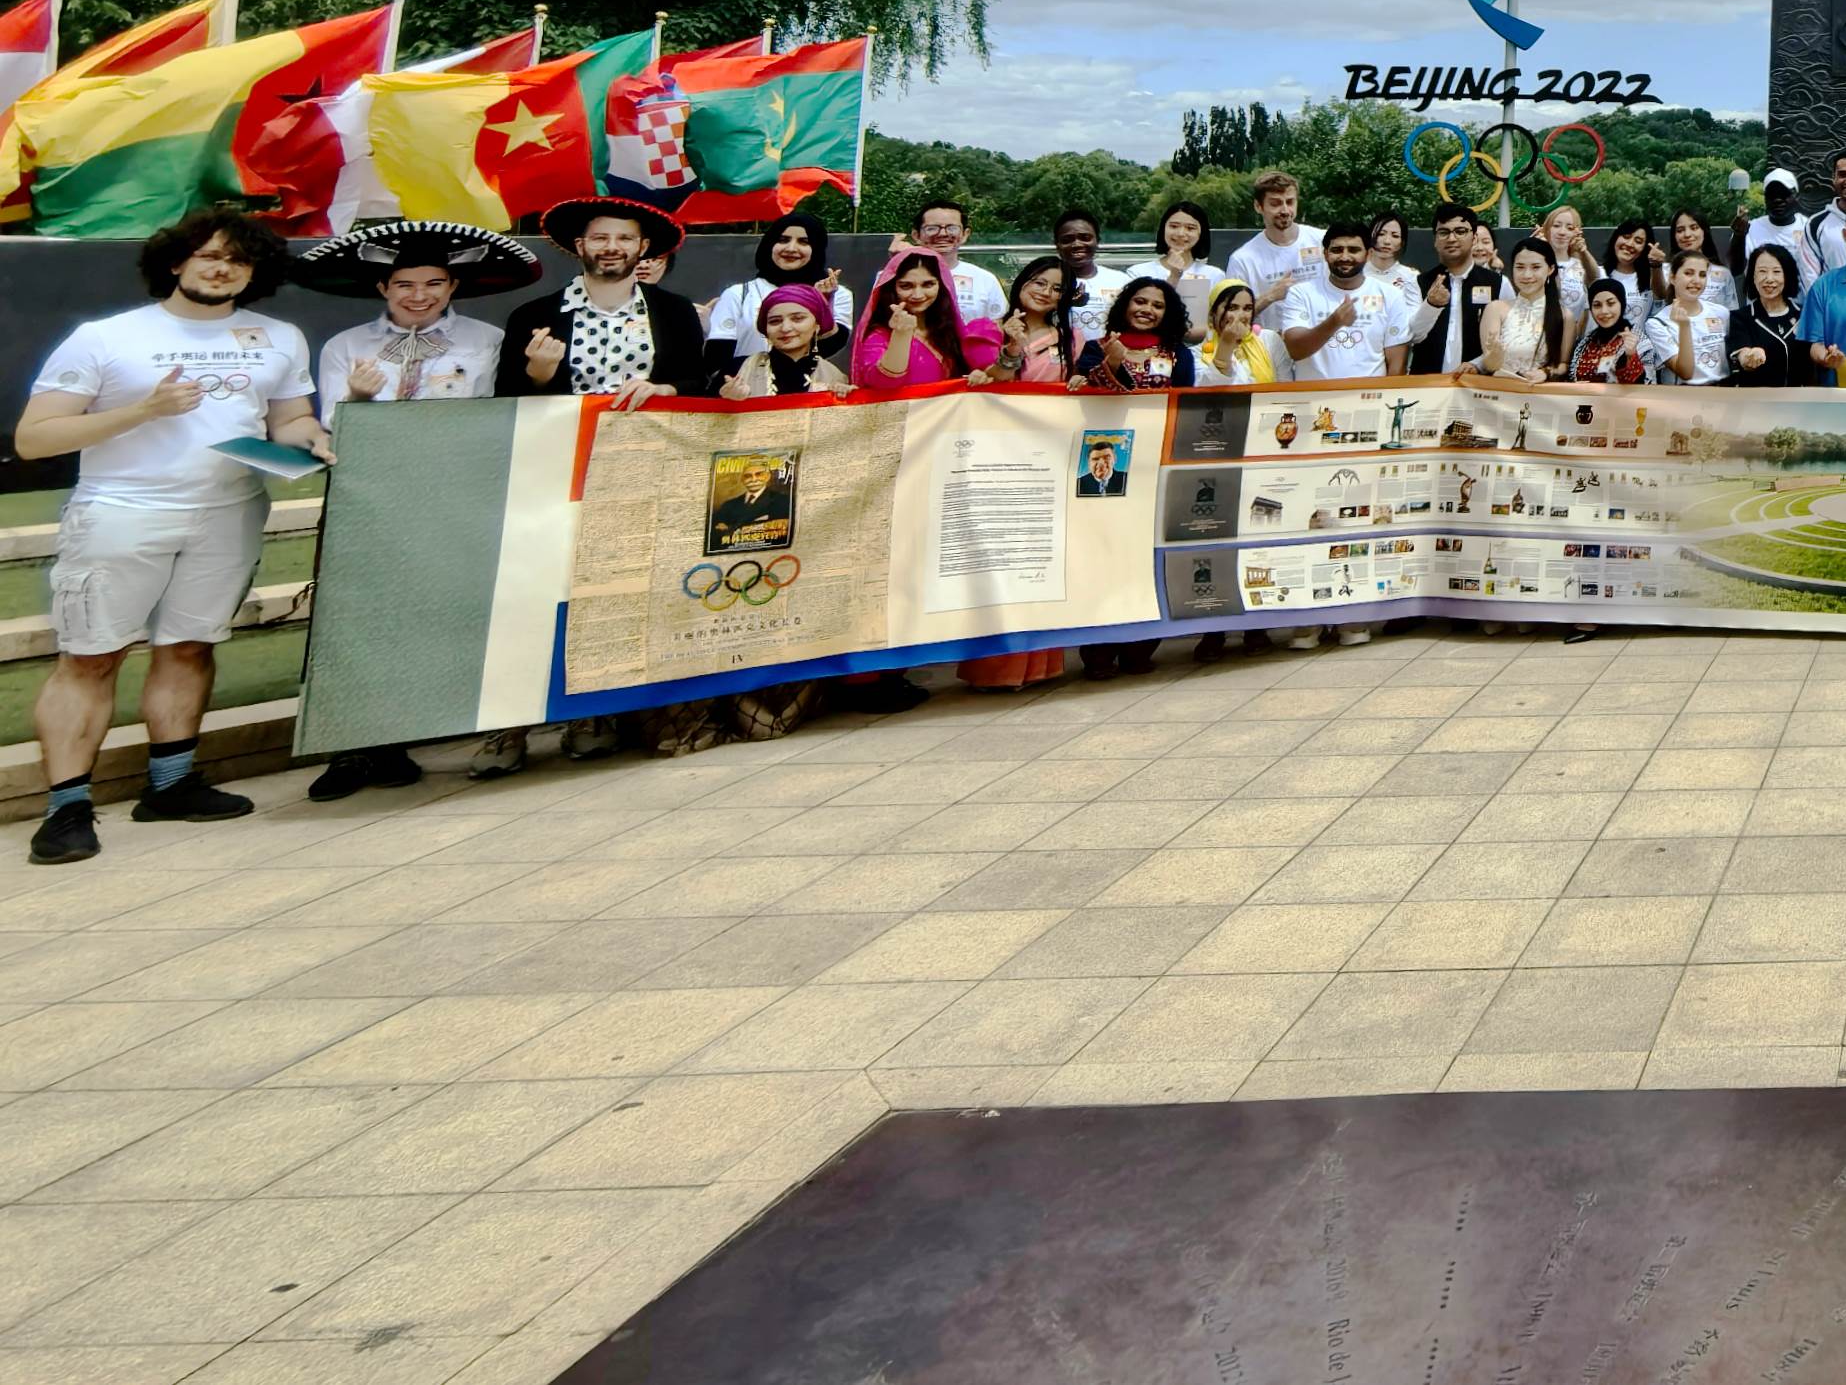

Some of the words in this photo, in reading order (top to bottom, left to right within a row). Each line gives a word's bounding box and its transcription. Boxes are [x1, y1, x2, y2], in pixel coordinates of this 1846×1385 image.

[1344, 64, 1522, 112] BEIJING
[1534, 69, 1664, 107] 2022
[1327, 1318, 1350, 1348] Rio
[1328, 1351, 1352, 1371] de
